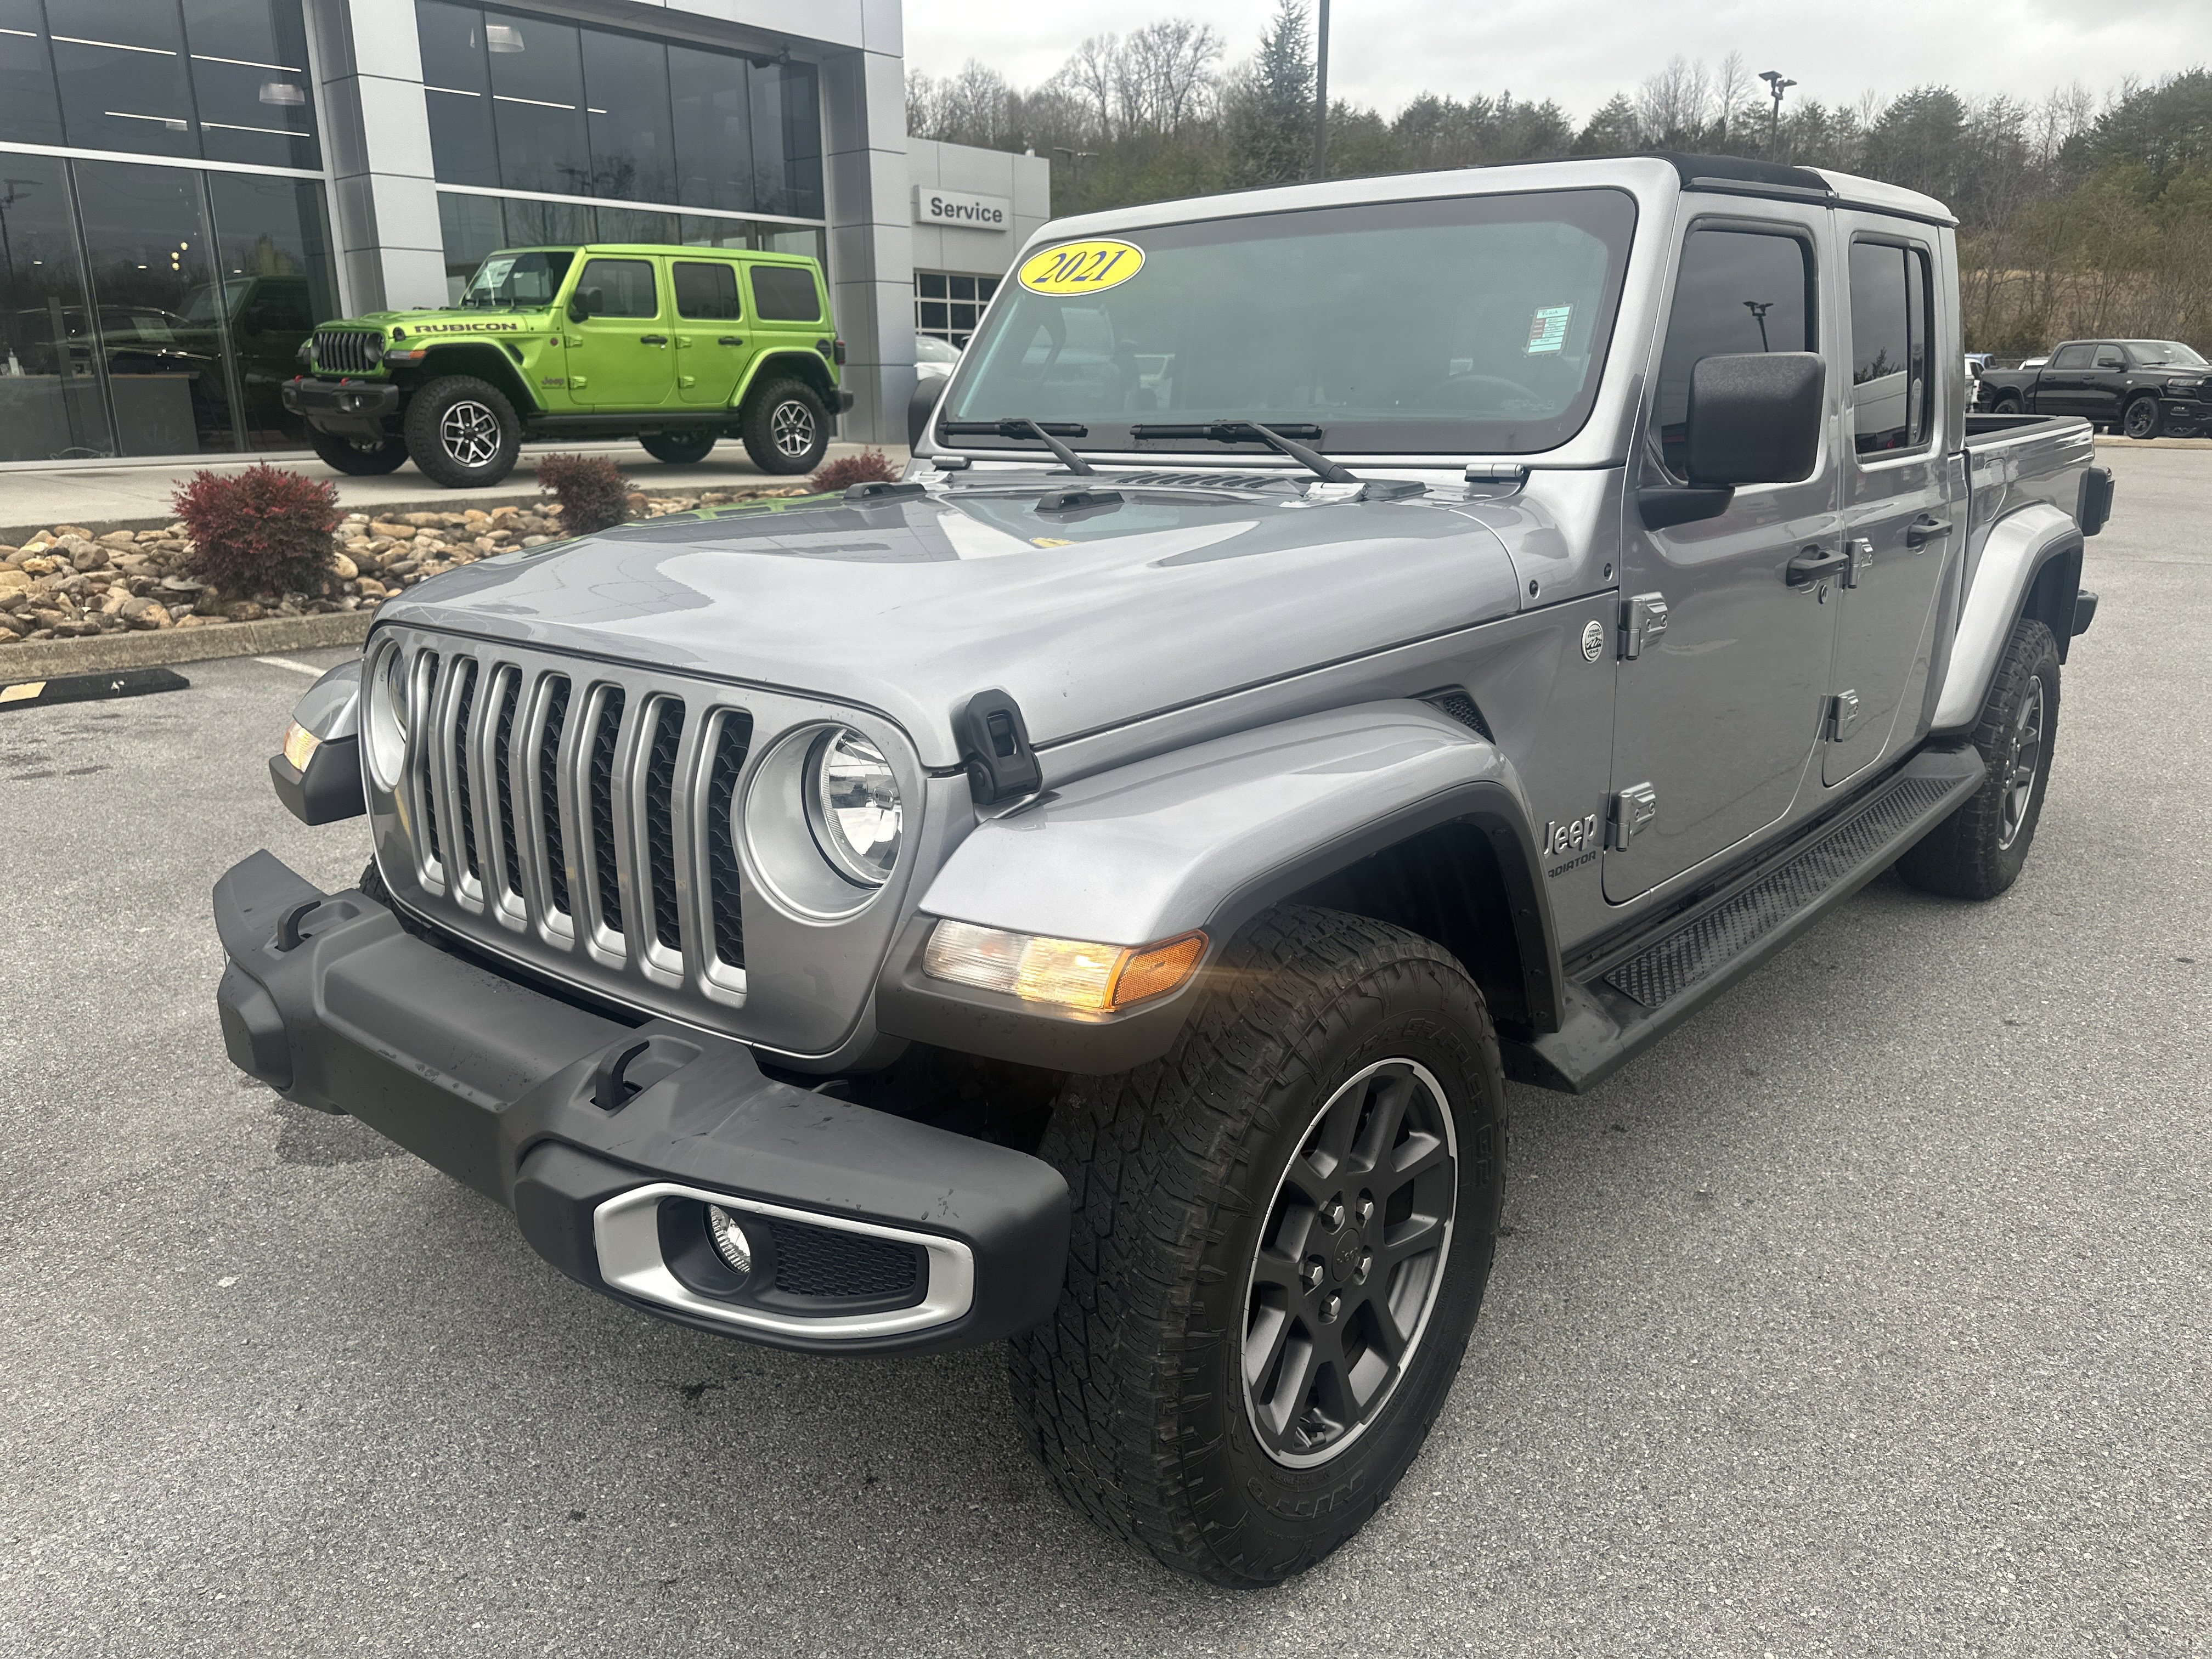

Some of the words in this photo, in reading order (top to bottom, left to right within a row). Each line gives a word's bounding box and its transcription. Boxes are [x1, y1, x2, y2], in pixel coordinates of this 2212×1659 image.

[930, 196, 1003, 223] Service
[1031, 249, 1128, 284] 2021
[414, 323, 517, 334] RUBICON
[1544, 814, 1597, 859] Jeep
